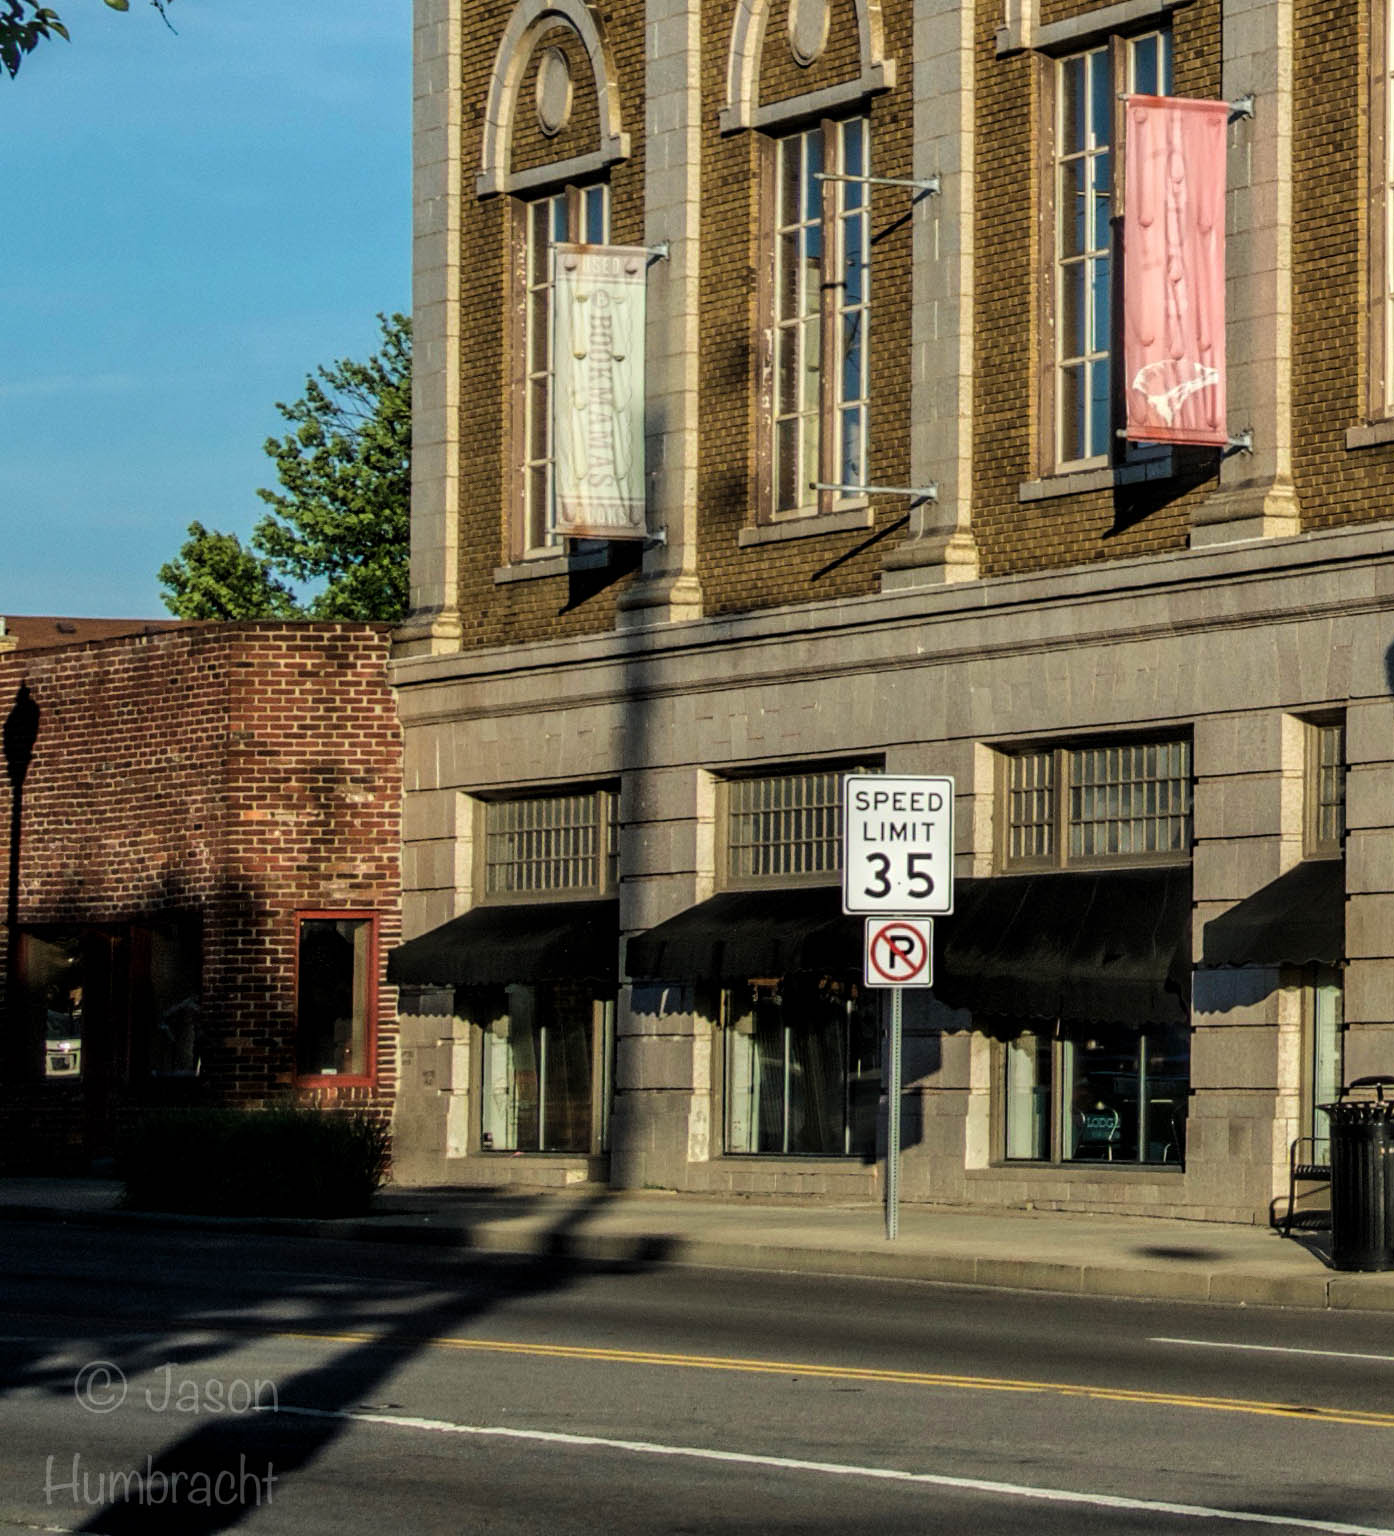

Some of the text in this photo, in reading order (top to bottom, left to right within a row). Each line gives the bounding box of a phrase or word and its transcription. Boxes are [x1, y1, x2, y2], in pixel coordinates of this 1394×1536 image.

[855, 791, 943, 812] SPEED
[863, 822, 935, 842] LIMIT
[864, 851, 935, 899] 35
